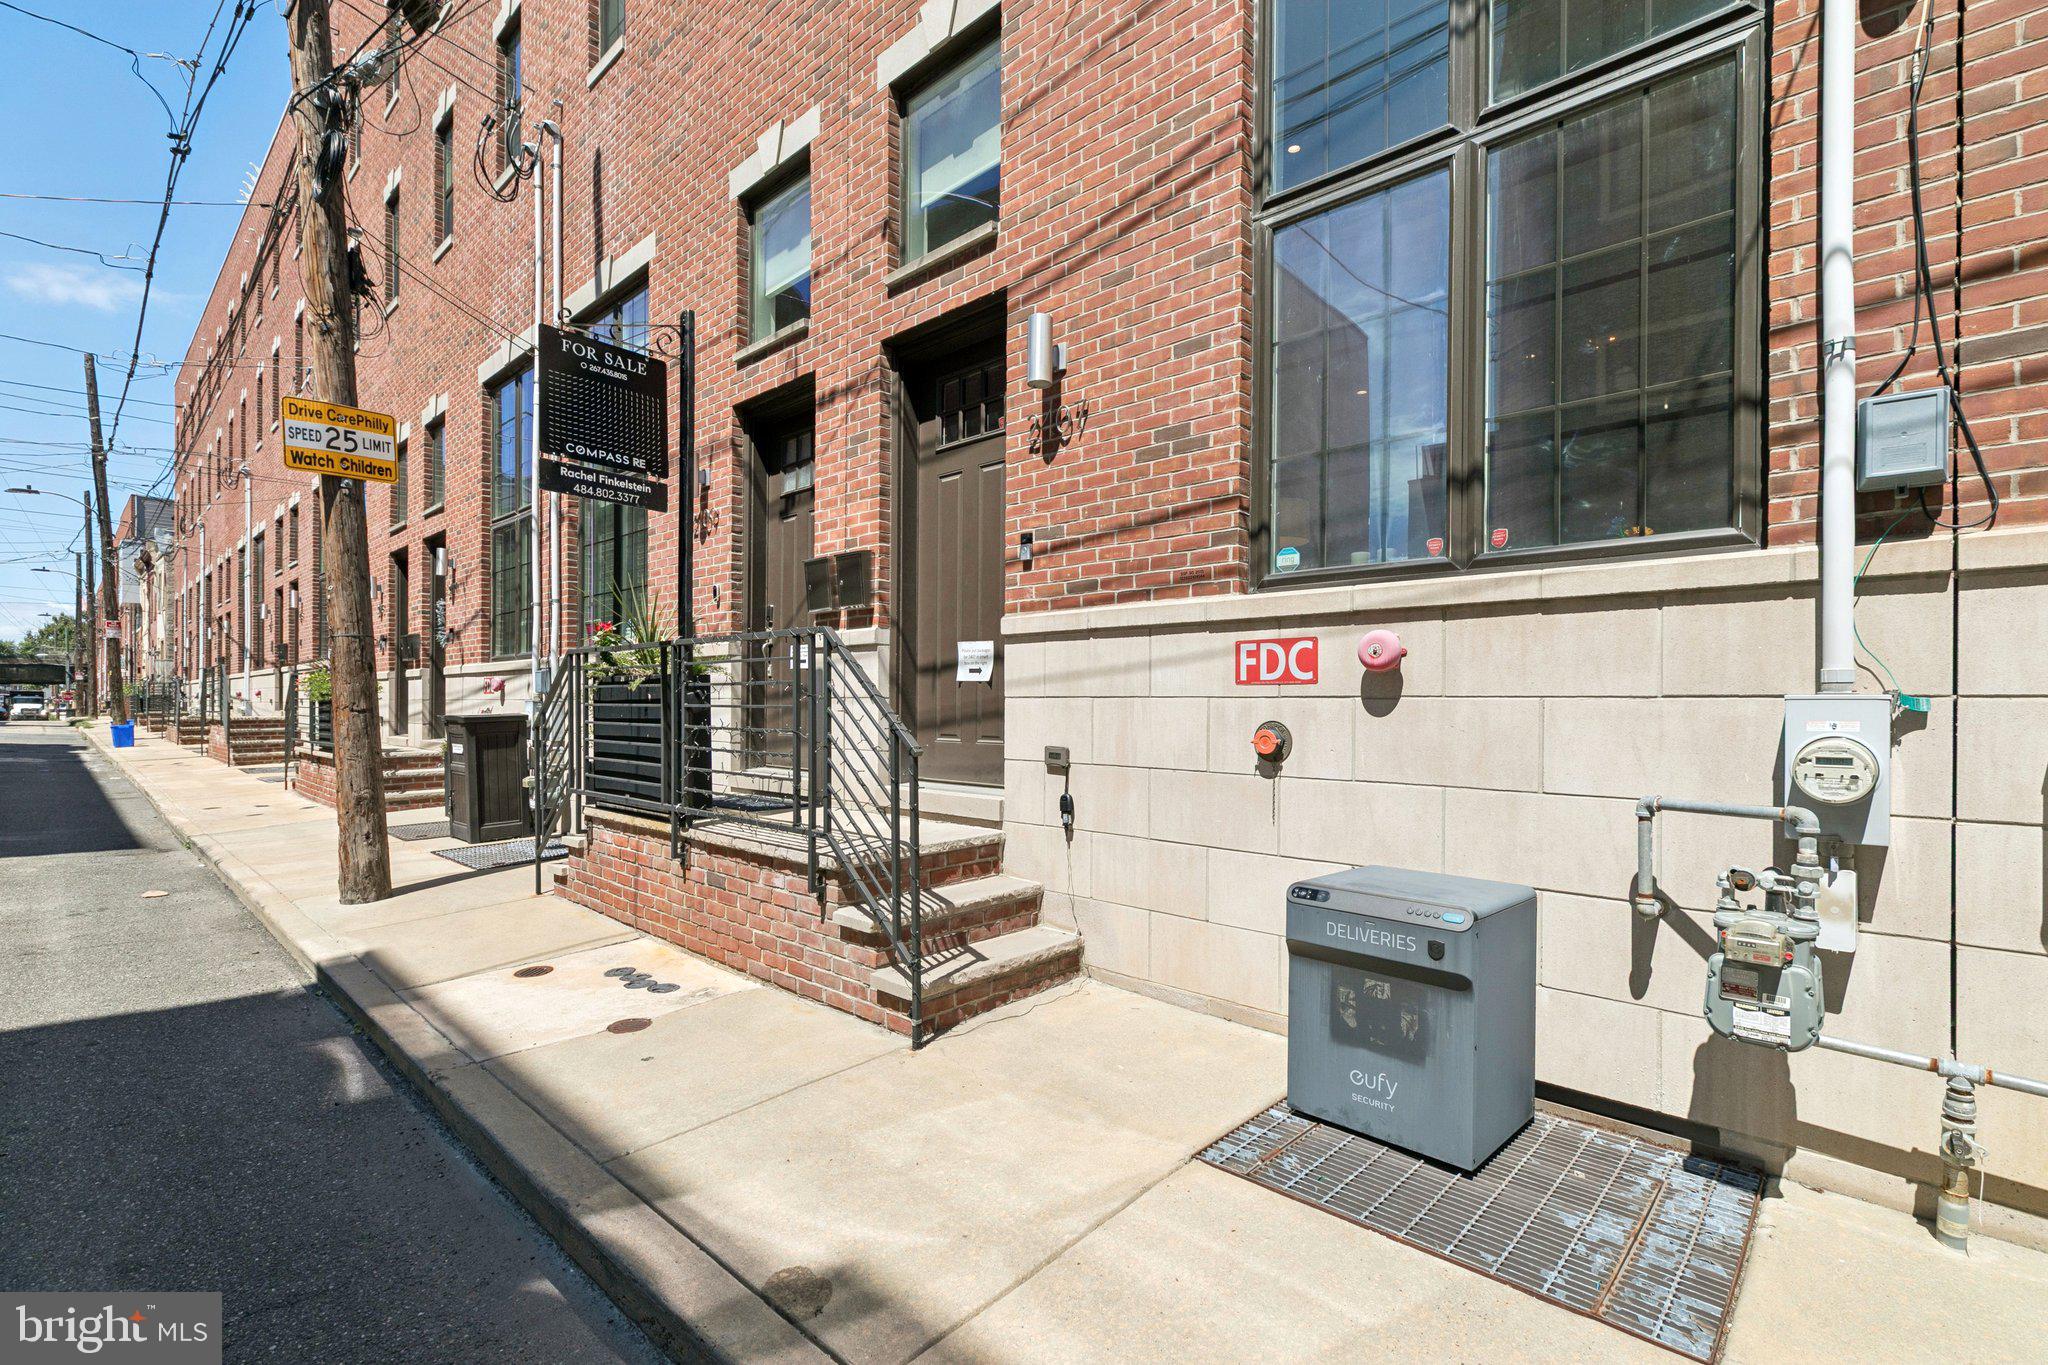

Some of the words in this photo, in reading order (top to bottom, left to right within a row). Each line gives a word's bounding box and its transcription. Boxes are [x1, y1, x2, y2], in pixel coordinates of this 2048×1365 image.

[561, 338, 598, 362] FOR
[604, 351, 648, 377] SALE
[288, 402, 323, 419] Drive
[327, 408, 389, 434] CarePhilly
[288, 426, 322, 443] SPEED
[325, 426, 358, 453] 25
[362, 437, 391, 454] LIMIT
[290, 450, 334, 469] Watch
[339, 457, 392, 478] Children
[565, 442, 630, 466] COMPASS
[632, 455, 647, 470] RE
[560, 466, 597, 484] Rachel
[598, 474, 652, 494] Finkelstein
[573, 484, 640, 504] 484.802.3377
[1239, 639, 1314, 681] FDC
[1325, 921, 1417, 953] DELIVERIES
[1349, 1069, 1398, 1100] eufy
[1351, 1092, 1395, 1113] SECURITY
